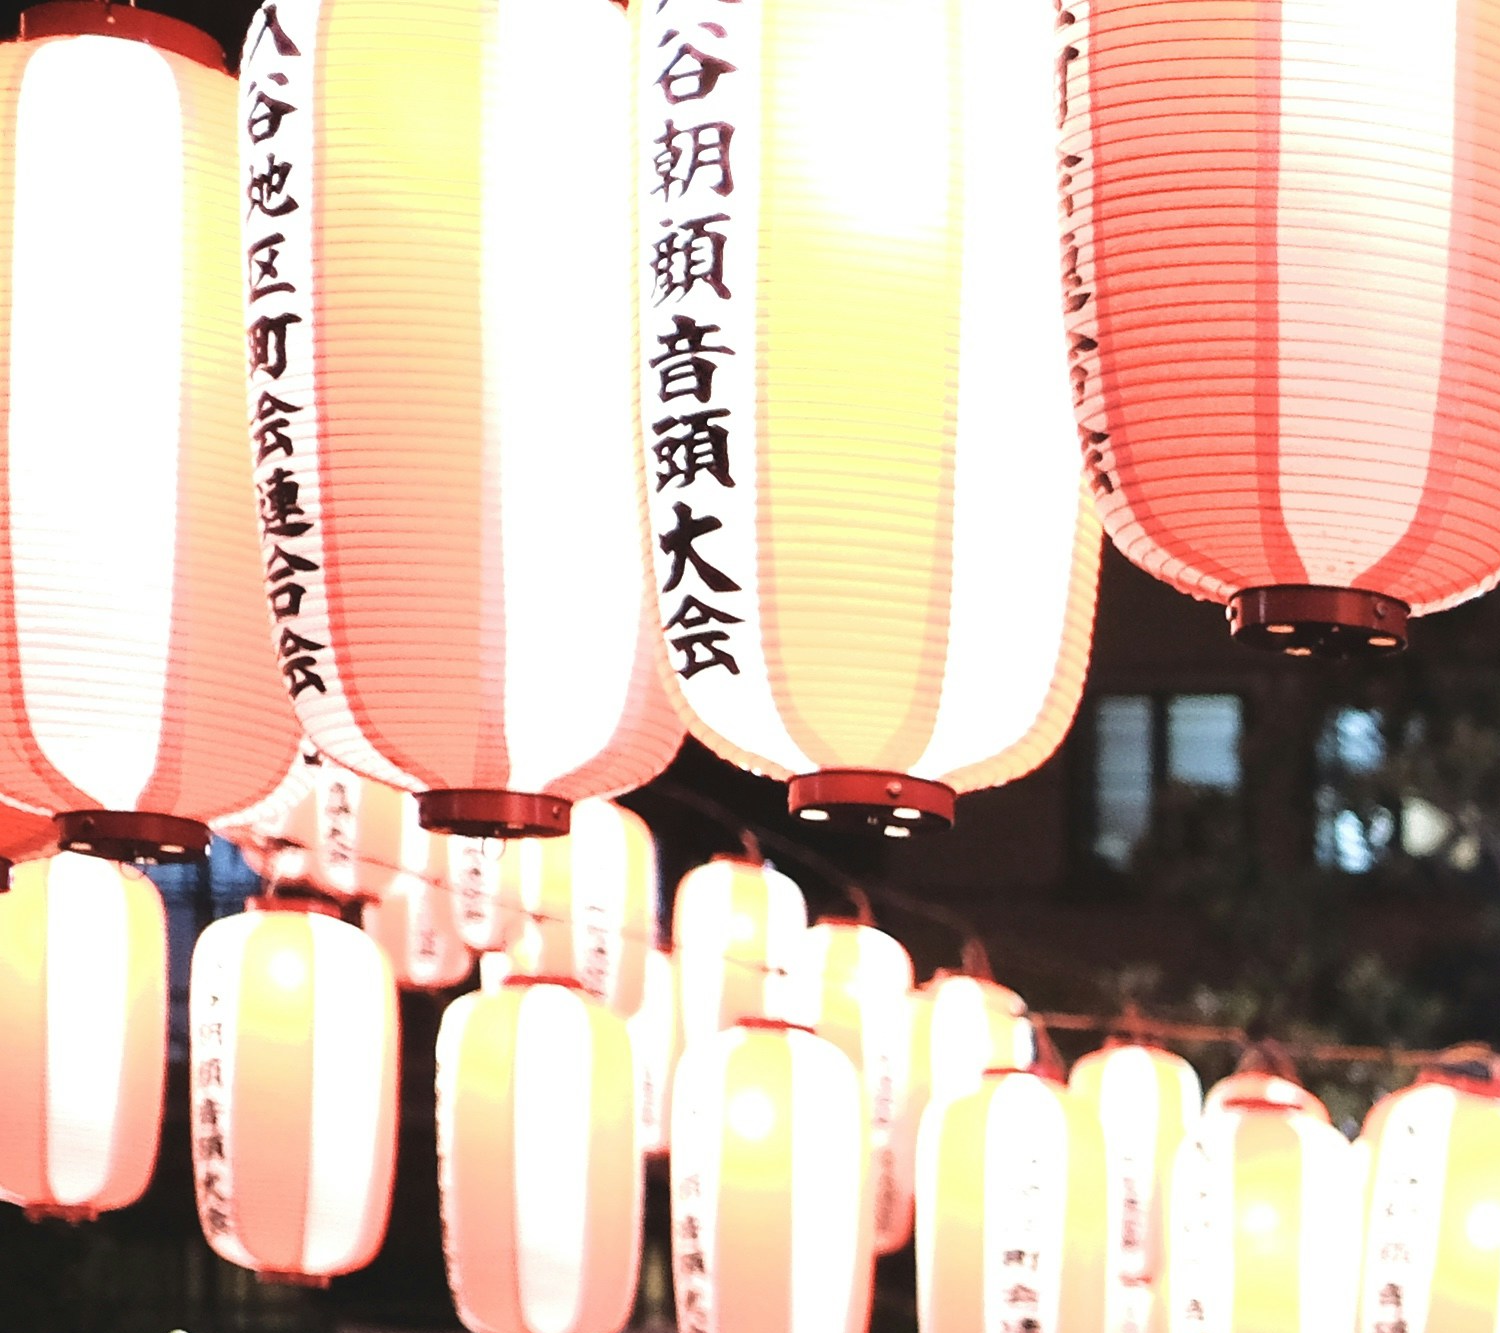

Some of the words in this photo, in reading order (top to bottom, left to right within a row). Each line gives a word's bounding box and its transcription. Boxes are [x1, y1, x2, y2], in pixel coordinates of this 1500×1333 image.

[649, 0, 746, 679] 谷朝顔音頭大会
